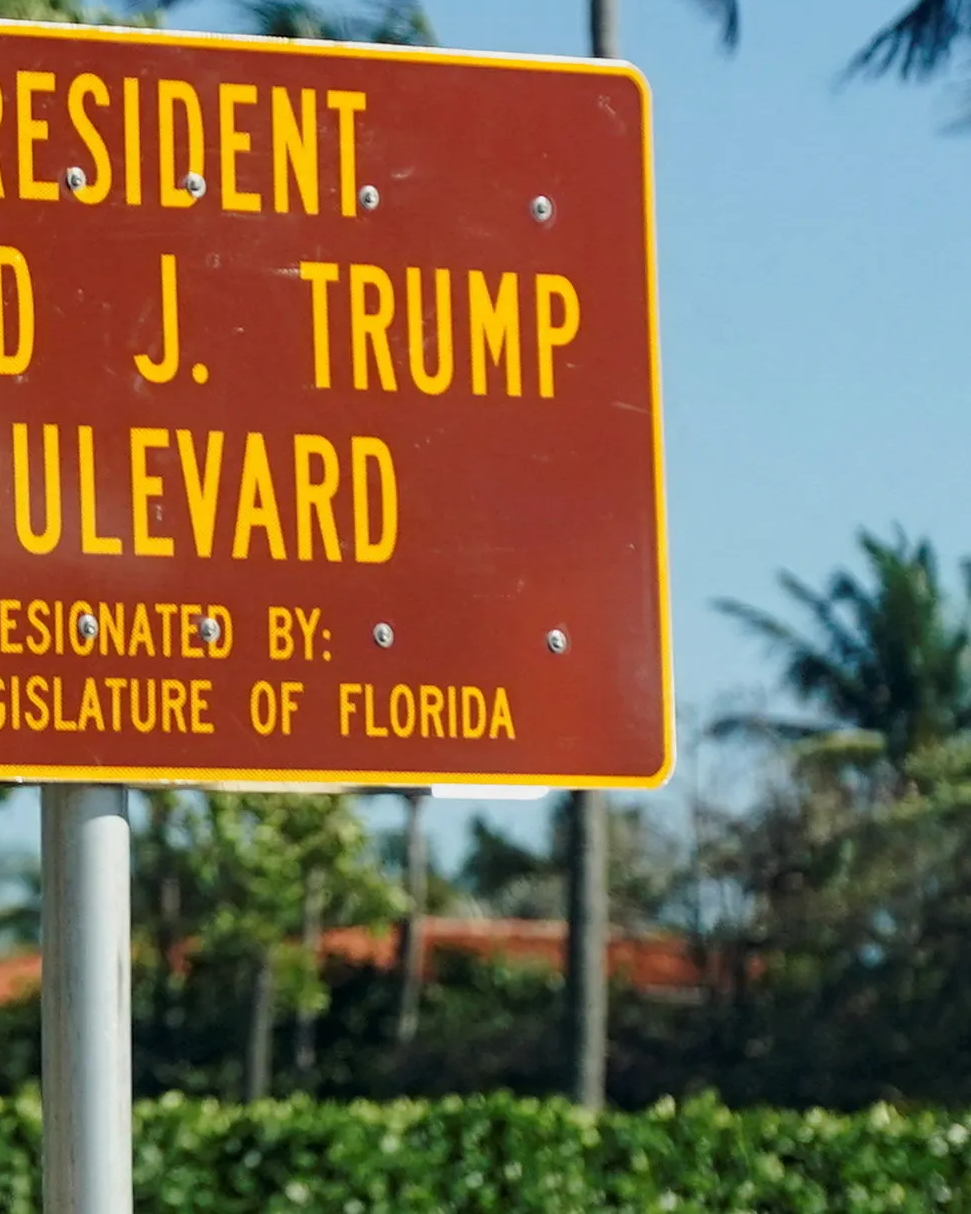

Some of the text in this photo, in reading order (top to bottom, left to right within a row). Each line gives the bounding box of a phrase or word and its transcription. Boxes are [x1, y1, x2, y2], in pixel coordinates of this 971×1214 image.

[132, 253, 209, 385] J.
[299, 261, 582, 399] TRUMP
[268, 606, 333, 662] BY:
[250, 681, 304, 735] OF
[339, 683, 515, 739] FLORIDA
